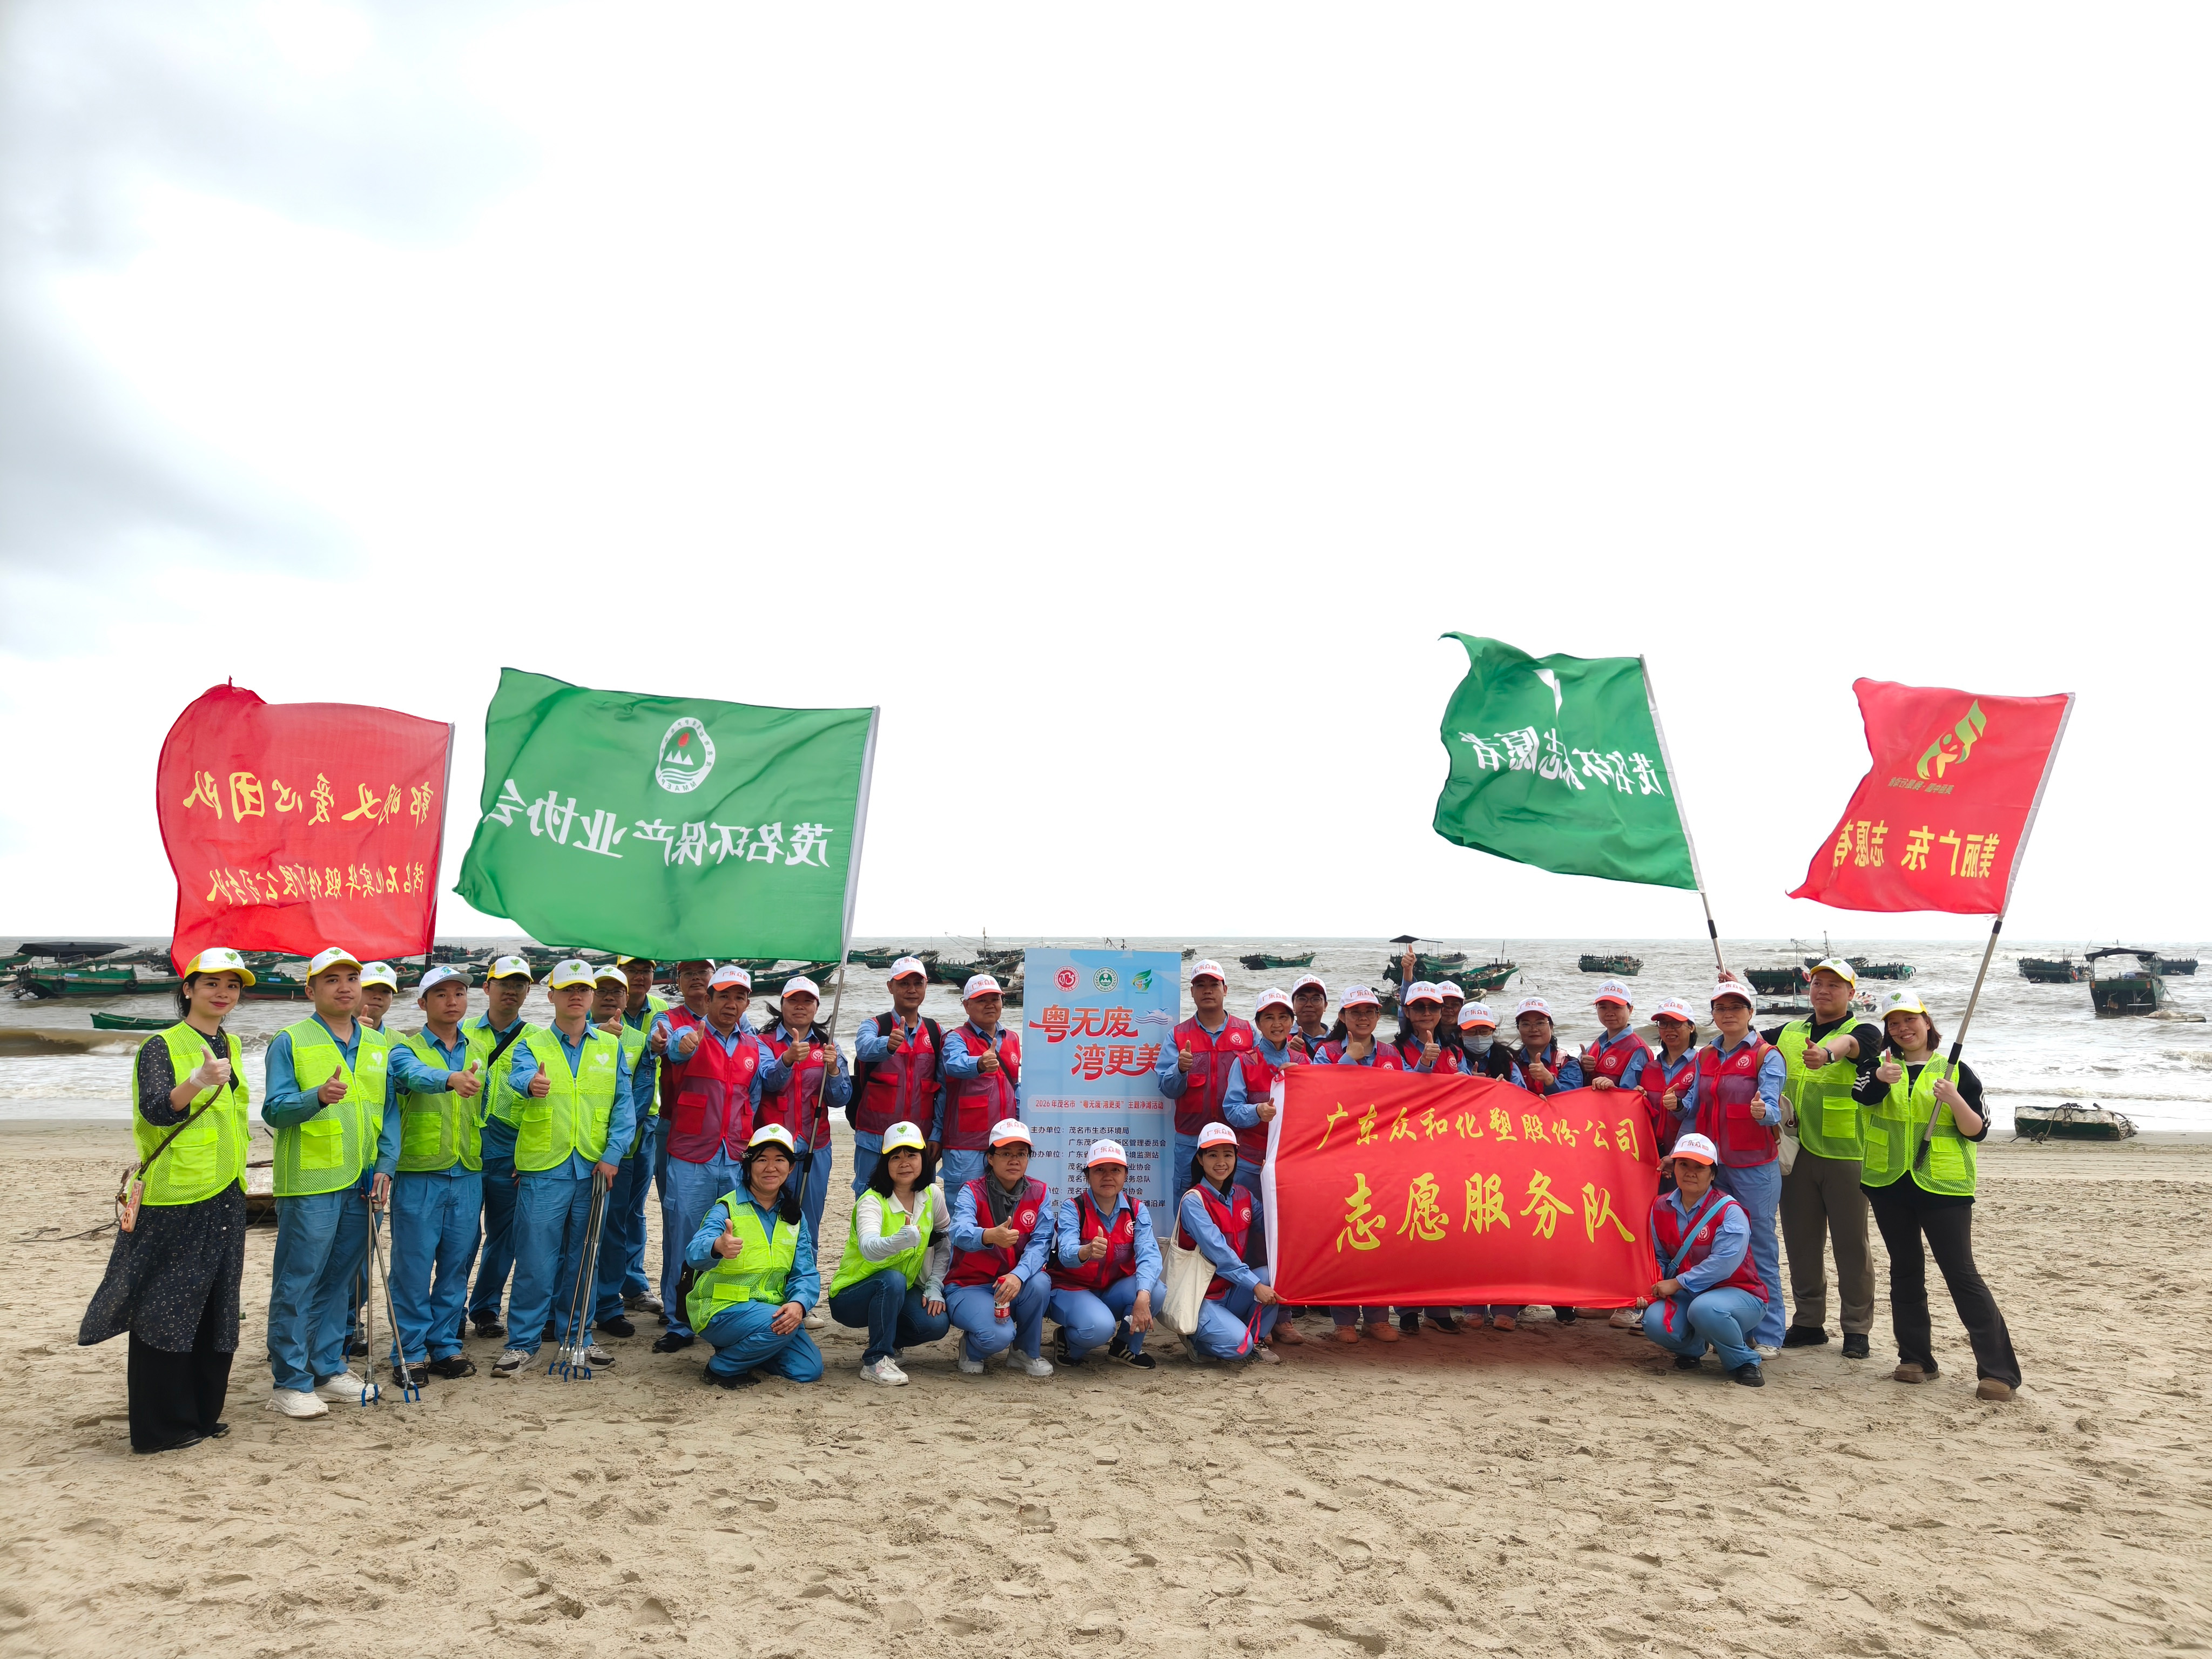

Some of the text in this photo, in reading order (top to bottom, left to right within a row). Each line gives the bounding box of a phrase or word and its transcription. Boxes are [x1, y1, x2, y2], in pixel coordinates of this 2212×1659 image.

[1029, 1004, 1139, 1043] 粤无废
[1071, 1043, 1162, 1081] 湾更美
[1316, 1102, 1640, 1162] 广东众和化塑股份公司
[1336, 1169, 1635, 1253] 志愿服务队
